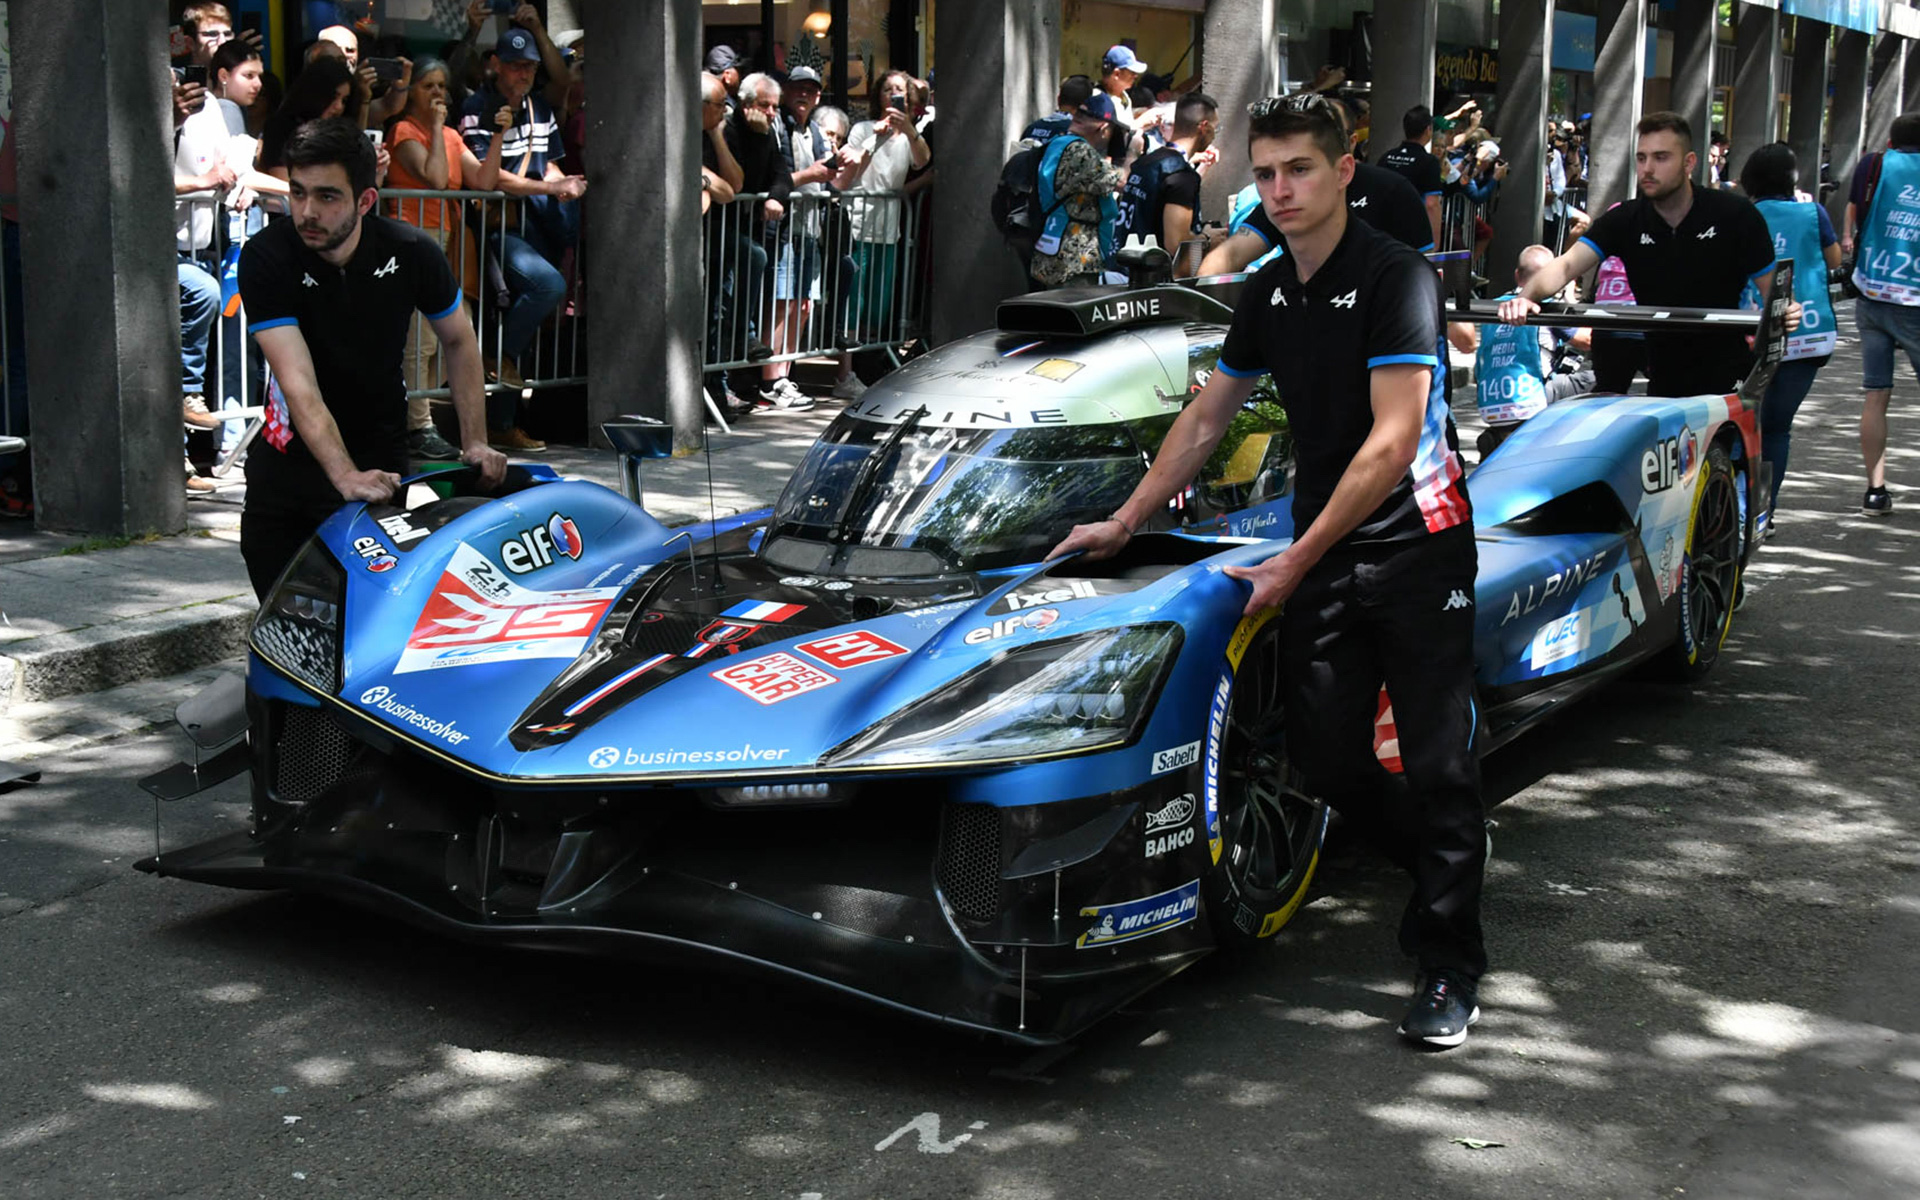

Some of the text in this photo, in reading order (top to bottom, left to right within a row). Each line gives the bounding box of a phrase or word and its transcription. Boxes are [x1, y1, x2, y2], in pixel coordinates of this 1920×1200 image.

[1436, 48, 1478, 87] egends
[1091, 298, 1160, 323] ALPINE
[1491, 342, 1516, 355] MEDIA
[1491, 355, 1516, 368] TRACK
[1480, 373, 1533, 403] 1408
[849, 402, 1068, 424] ALPINE
[1641, 436, 1679, 494] elf
[353, 536, 388, 558] elf
[501, 524, 554, 575] elf
[1005, 581, 1098, 611] ixell
[1500, 551, 1607, 627] ALPINE
[416, 592, 606, 643] 35
[964, 616, 1024, 645] elf
[1545, 615, 1581, 646] WEC
[436, 640, 549, 660] WEC
[811, 635, 894, 661] HY
[724, 663, 801, 700] CAR
[758, 655, 828, 687] HYPER
[377, 693, 470, 745] businessolver
[624, 744, 791, 765] businessolver
[1157, 744, 1197, 771] Sabelt
[1208, 675, 1231, 812] MICHELIN
[1145, 827, 1195, 858] BAHCO
[1119, 895, 1197, 931] MICHELIN
